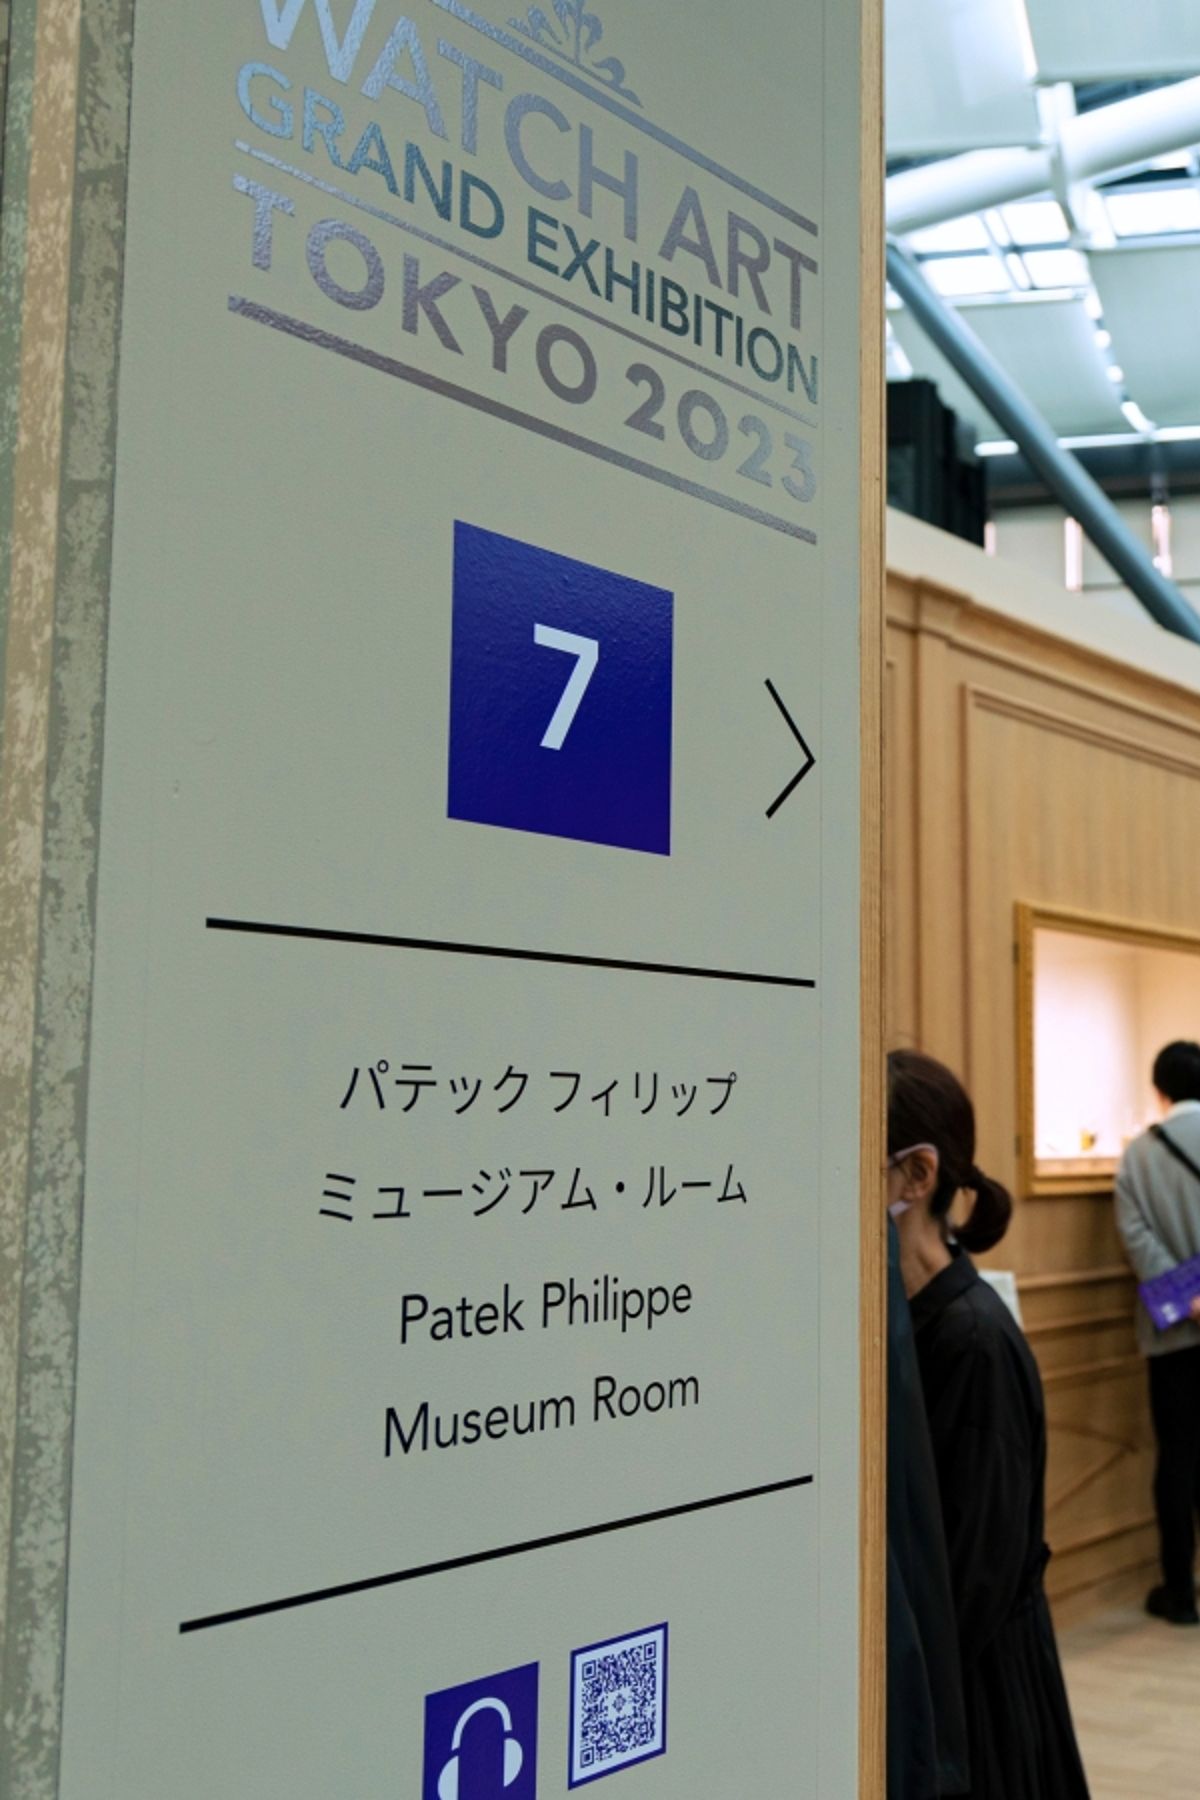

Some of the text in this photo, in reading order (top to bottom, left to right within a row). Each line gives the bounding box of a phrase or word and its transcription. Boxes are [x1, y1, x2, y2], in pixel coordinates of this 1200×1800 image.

[236, 60, 819, 405] GRAND EXHIBITION
[657, 186, 819, 330] ART
[232, 173, 818, 503] TOKYO 2023
[533, 622, 599, 751] 7
[339, 1059, 738, 1117] パテック フィリップ
[318, 1164, 748, 1222] ミュージアム・ルーム
[401, 1274, 692, 1344] Patek Philippe
[384, 1375, 700, 1457] Museum Room
